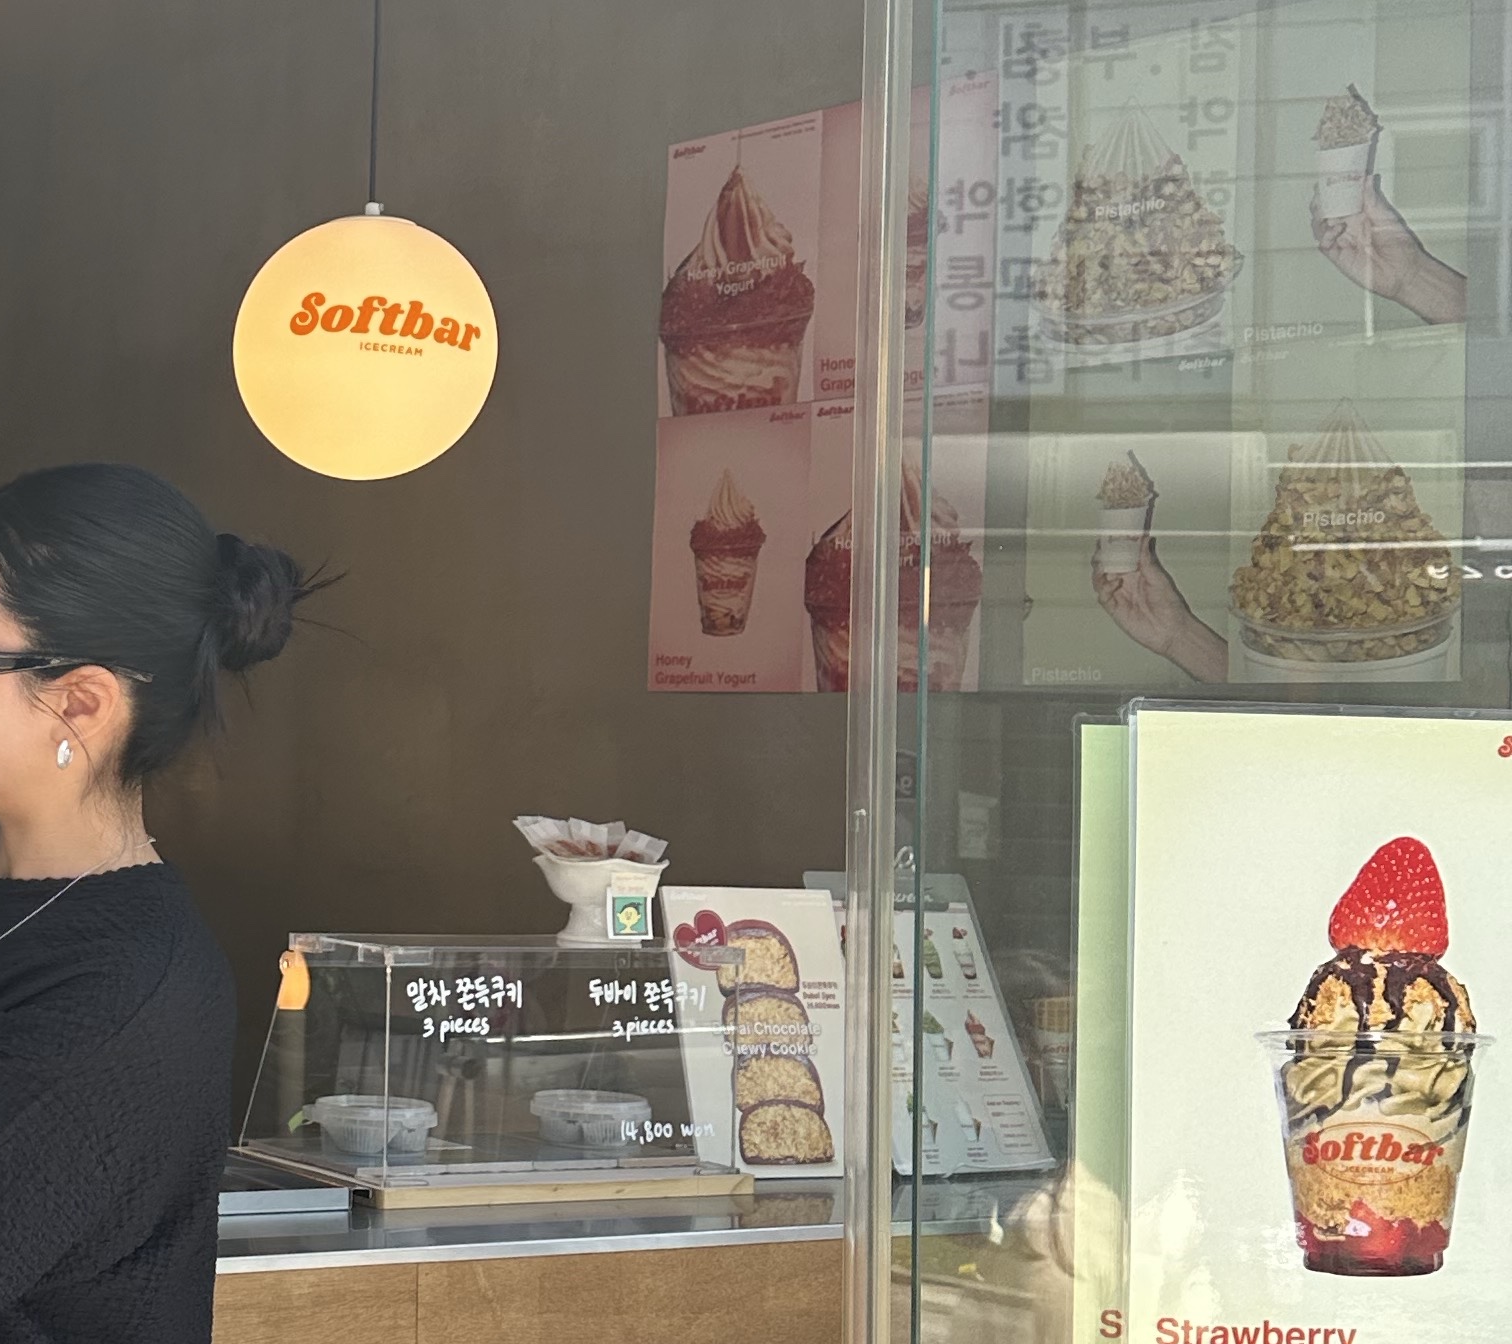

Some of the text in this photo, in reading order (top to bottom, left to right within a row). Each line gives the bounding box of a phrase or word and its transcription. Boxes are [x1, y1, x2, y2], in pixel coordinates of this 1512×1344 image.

[687, 254, 787, 283] Honey Grapefruit
[715, 278, 755, 297] Yogurt
[289, 291, 482, 353] Softbar
[359, 341, 424, 357] ICECREAM
[655, 653, 693, 669] Honey
[716, 671, 756, 689] Yogurt
[405, 977, 451, 1013] 말차
[588, 978, 638, 1007] 두바이
[422, 1016, 491, 1044] 3 pieces
[612, 1017, 676, 1043] 3 pieces
[753, 1021, 823, 1037] Chocolate
[769, 1041, 819, 1056] Cookie
[620, 1120, 717, 1145] 14,800 won
[1300, 1131, 1445, 1168] Softbar
